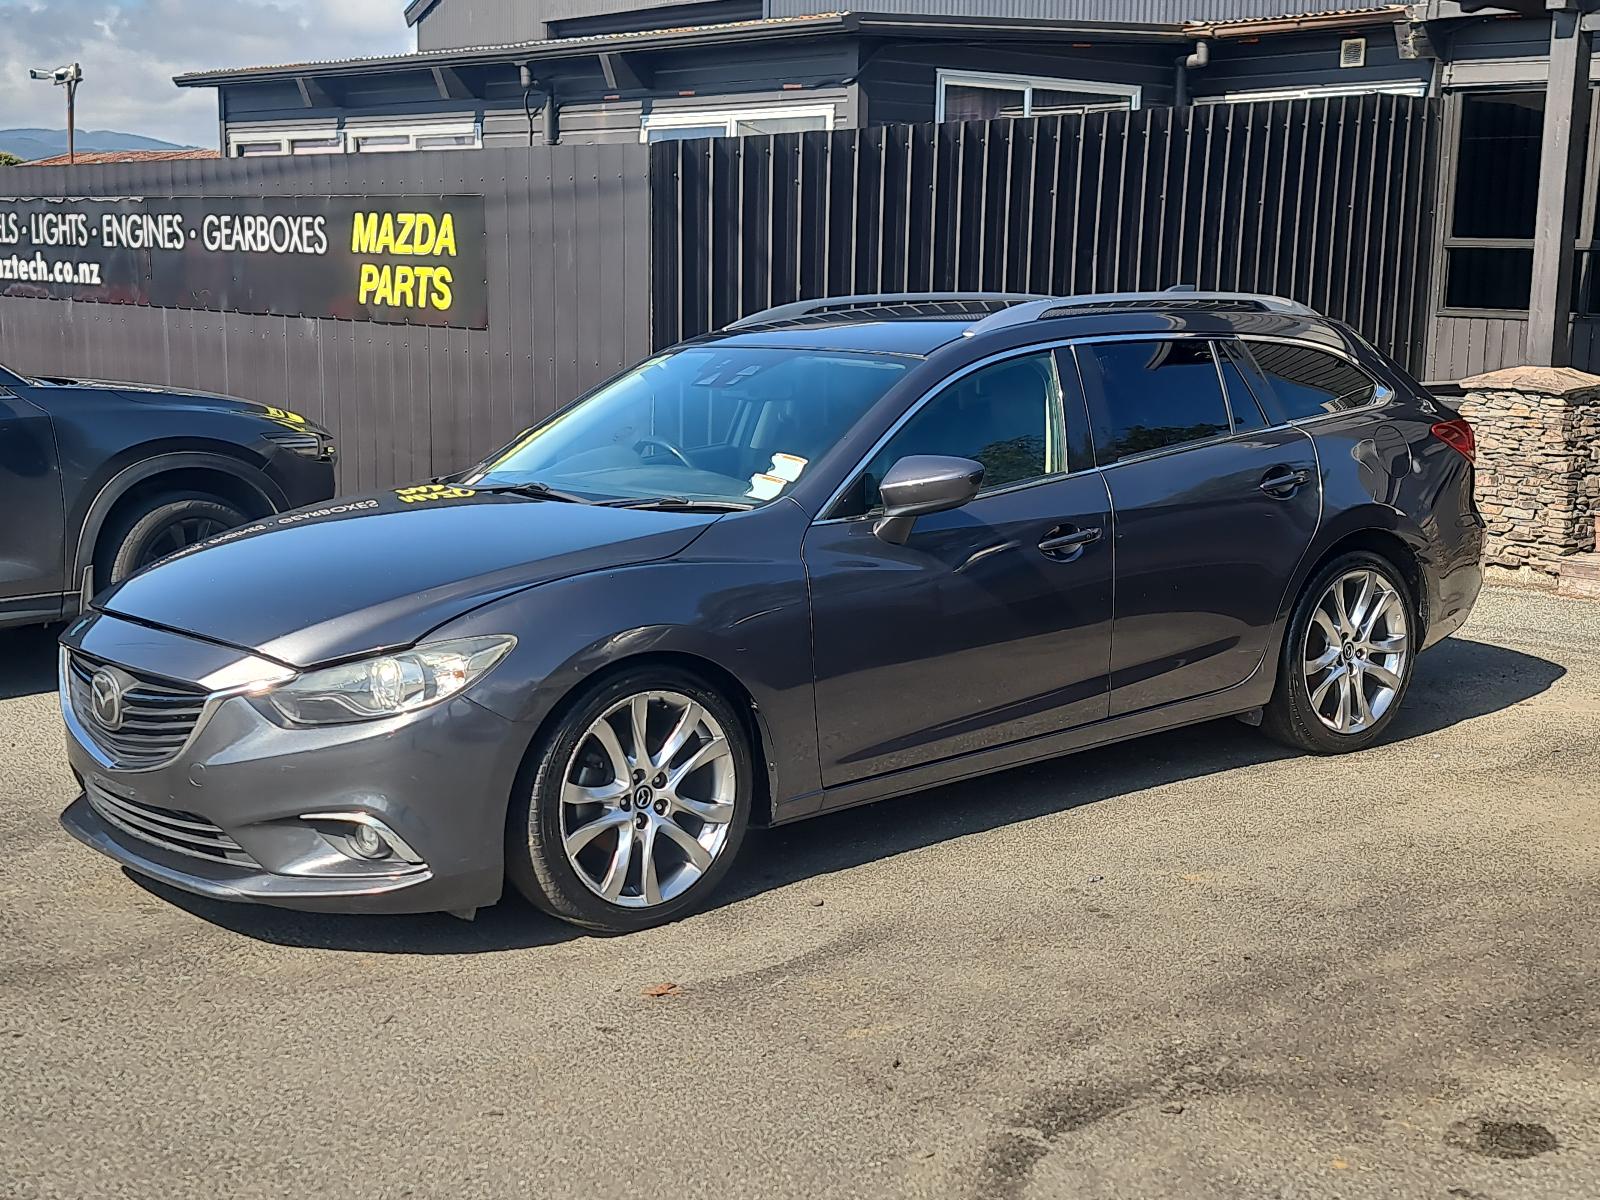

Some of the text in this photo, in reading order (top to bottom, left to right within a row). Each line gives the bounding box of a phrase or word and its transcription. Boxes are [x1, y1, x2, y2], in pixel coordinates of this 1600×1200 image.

[0, 213, 327, 254] LS LIGHTS ENGINES GEARBOXES
[351, 213, 457, 256] MAZDA
[358, 264, 453, 310] PARTS
